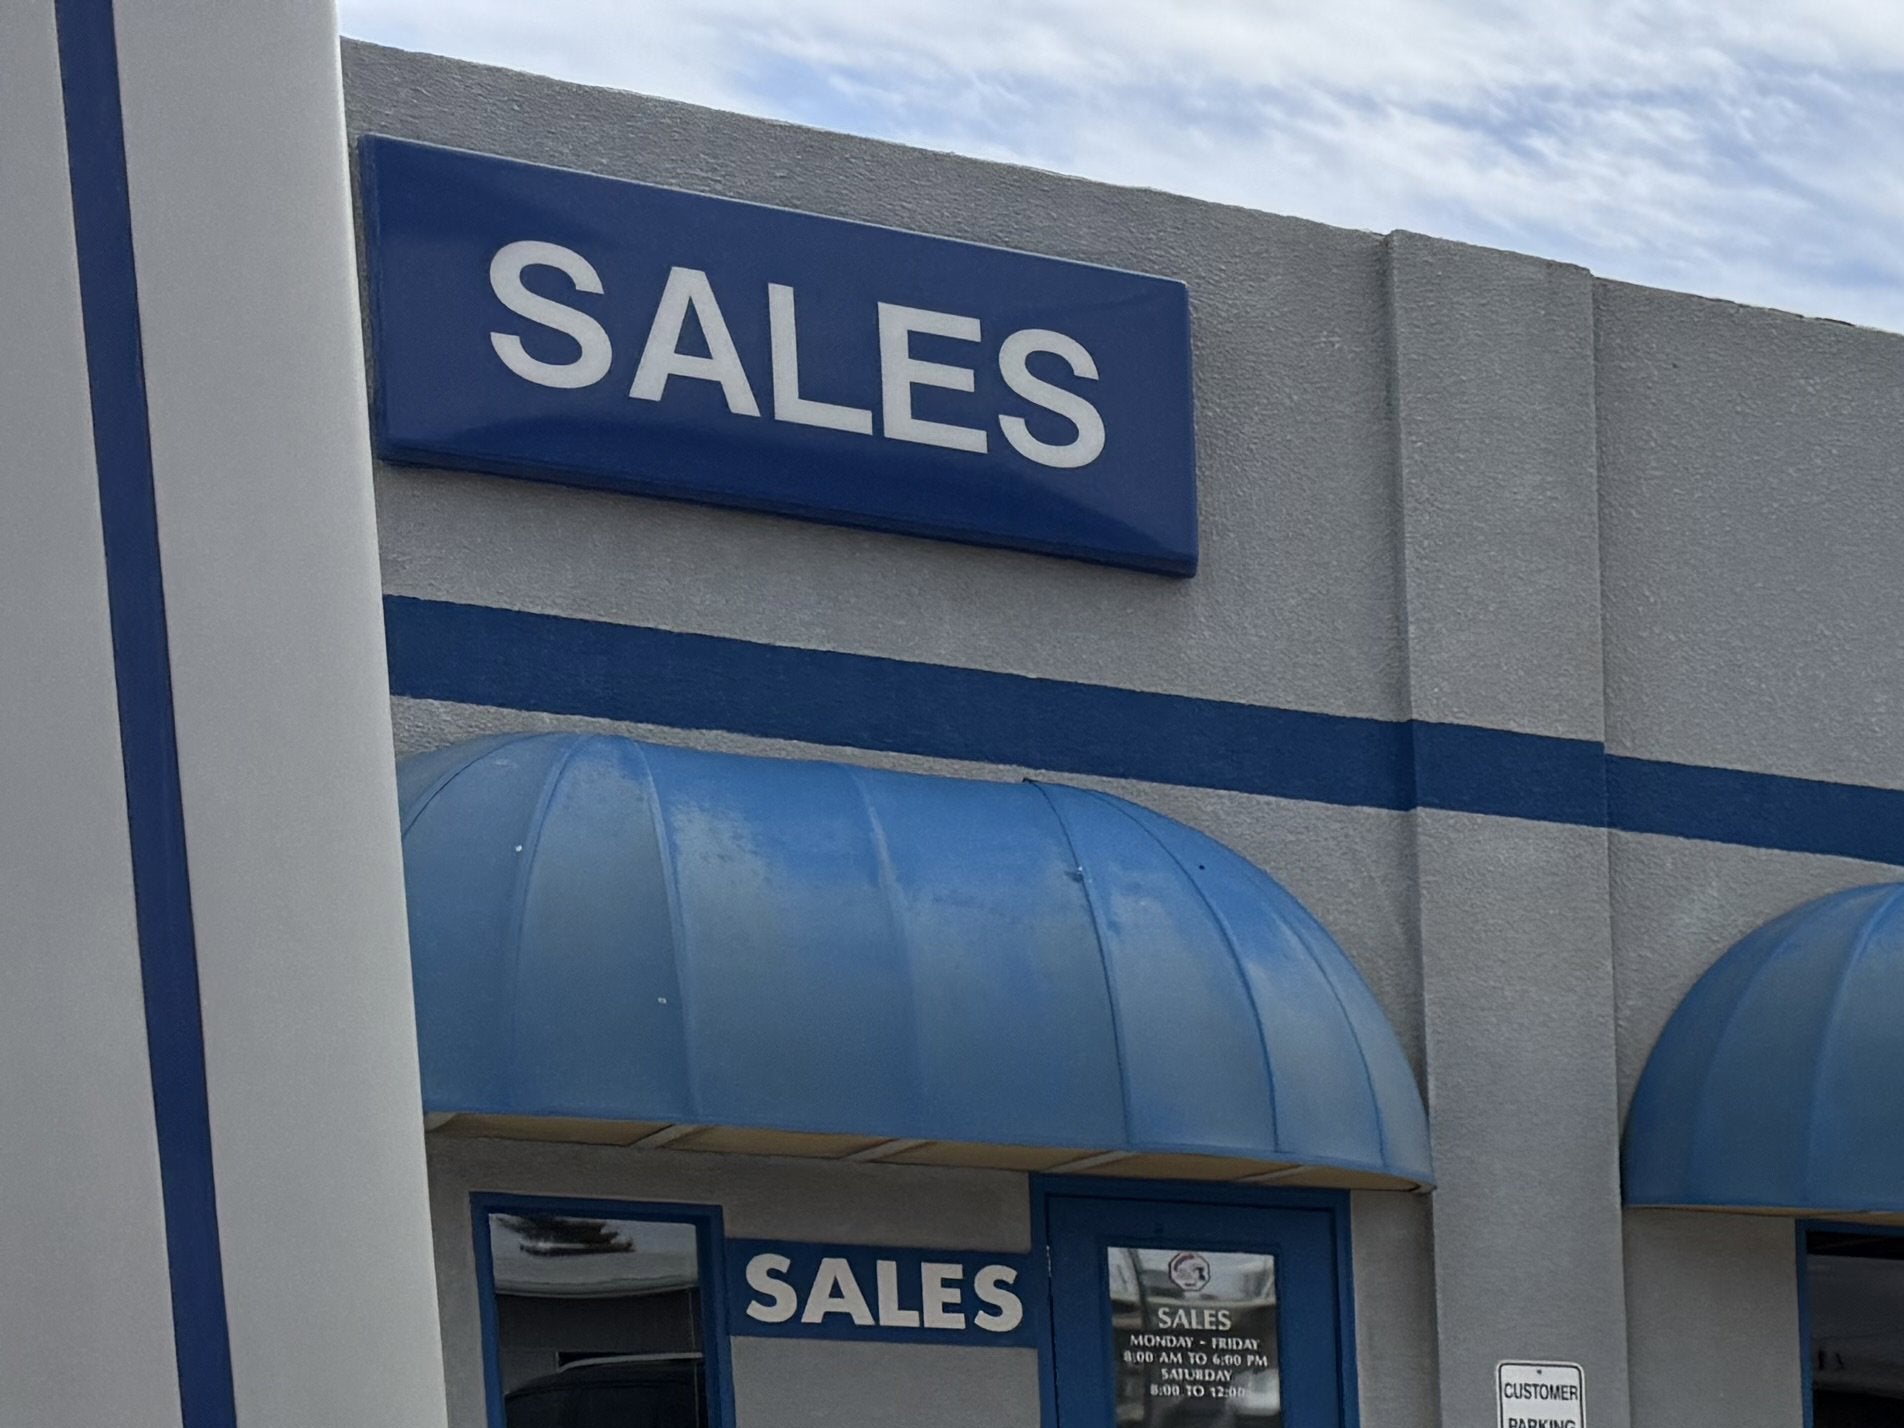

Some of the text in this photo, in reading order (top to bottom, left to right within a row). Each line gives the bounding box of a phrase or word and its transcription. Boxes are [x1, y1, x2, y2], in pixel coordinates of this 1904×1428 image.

[489, 239, 1106, 469] SALES
[744, 1252, 1024, 1332] SALES
[1158, 1307, 1232, 1331] SALES
[1130, 1334, 1194, 1349] MONDAY
[1211, 1337, 1260, 1351] FRIDAY
[1159, 1351, 1182, 1364] AM
[1187, 1351, 1207, 1365] TO
[1212, 1353, 1242, 1366] 6:00
[1246, 1354, 1268, 1367] PM
[1161, 1368, 1233, 1381] SATURDAY
[1150, 1384, 1246, 1398] 8:00 TO 12:00
[1504, 1382, 1578, 1400] CUSTOMER
